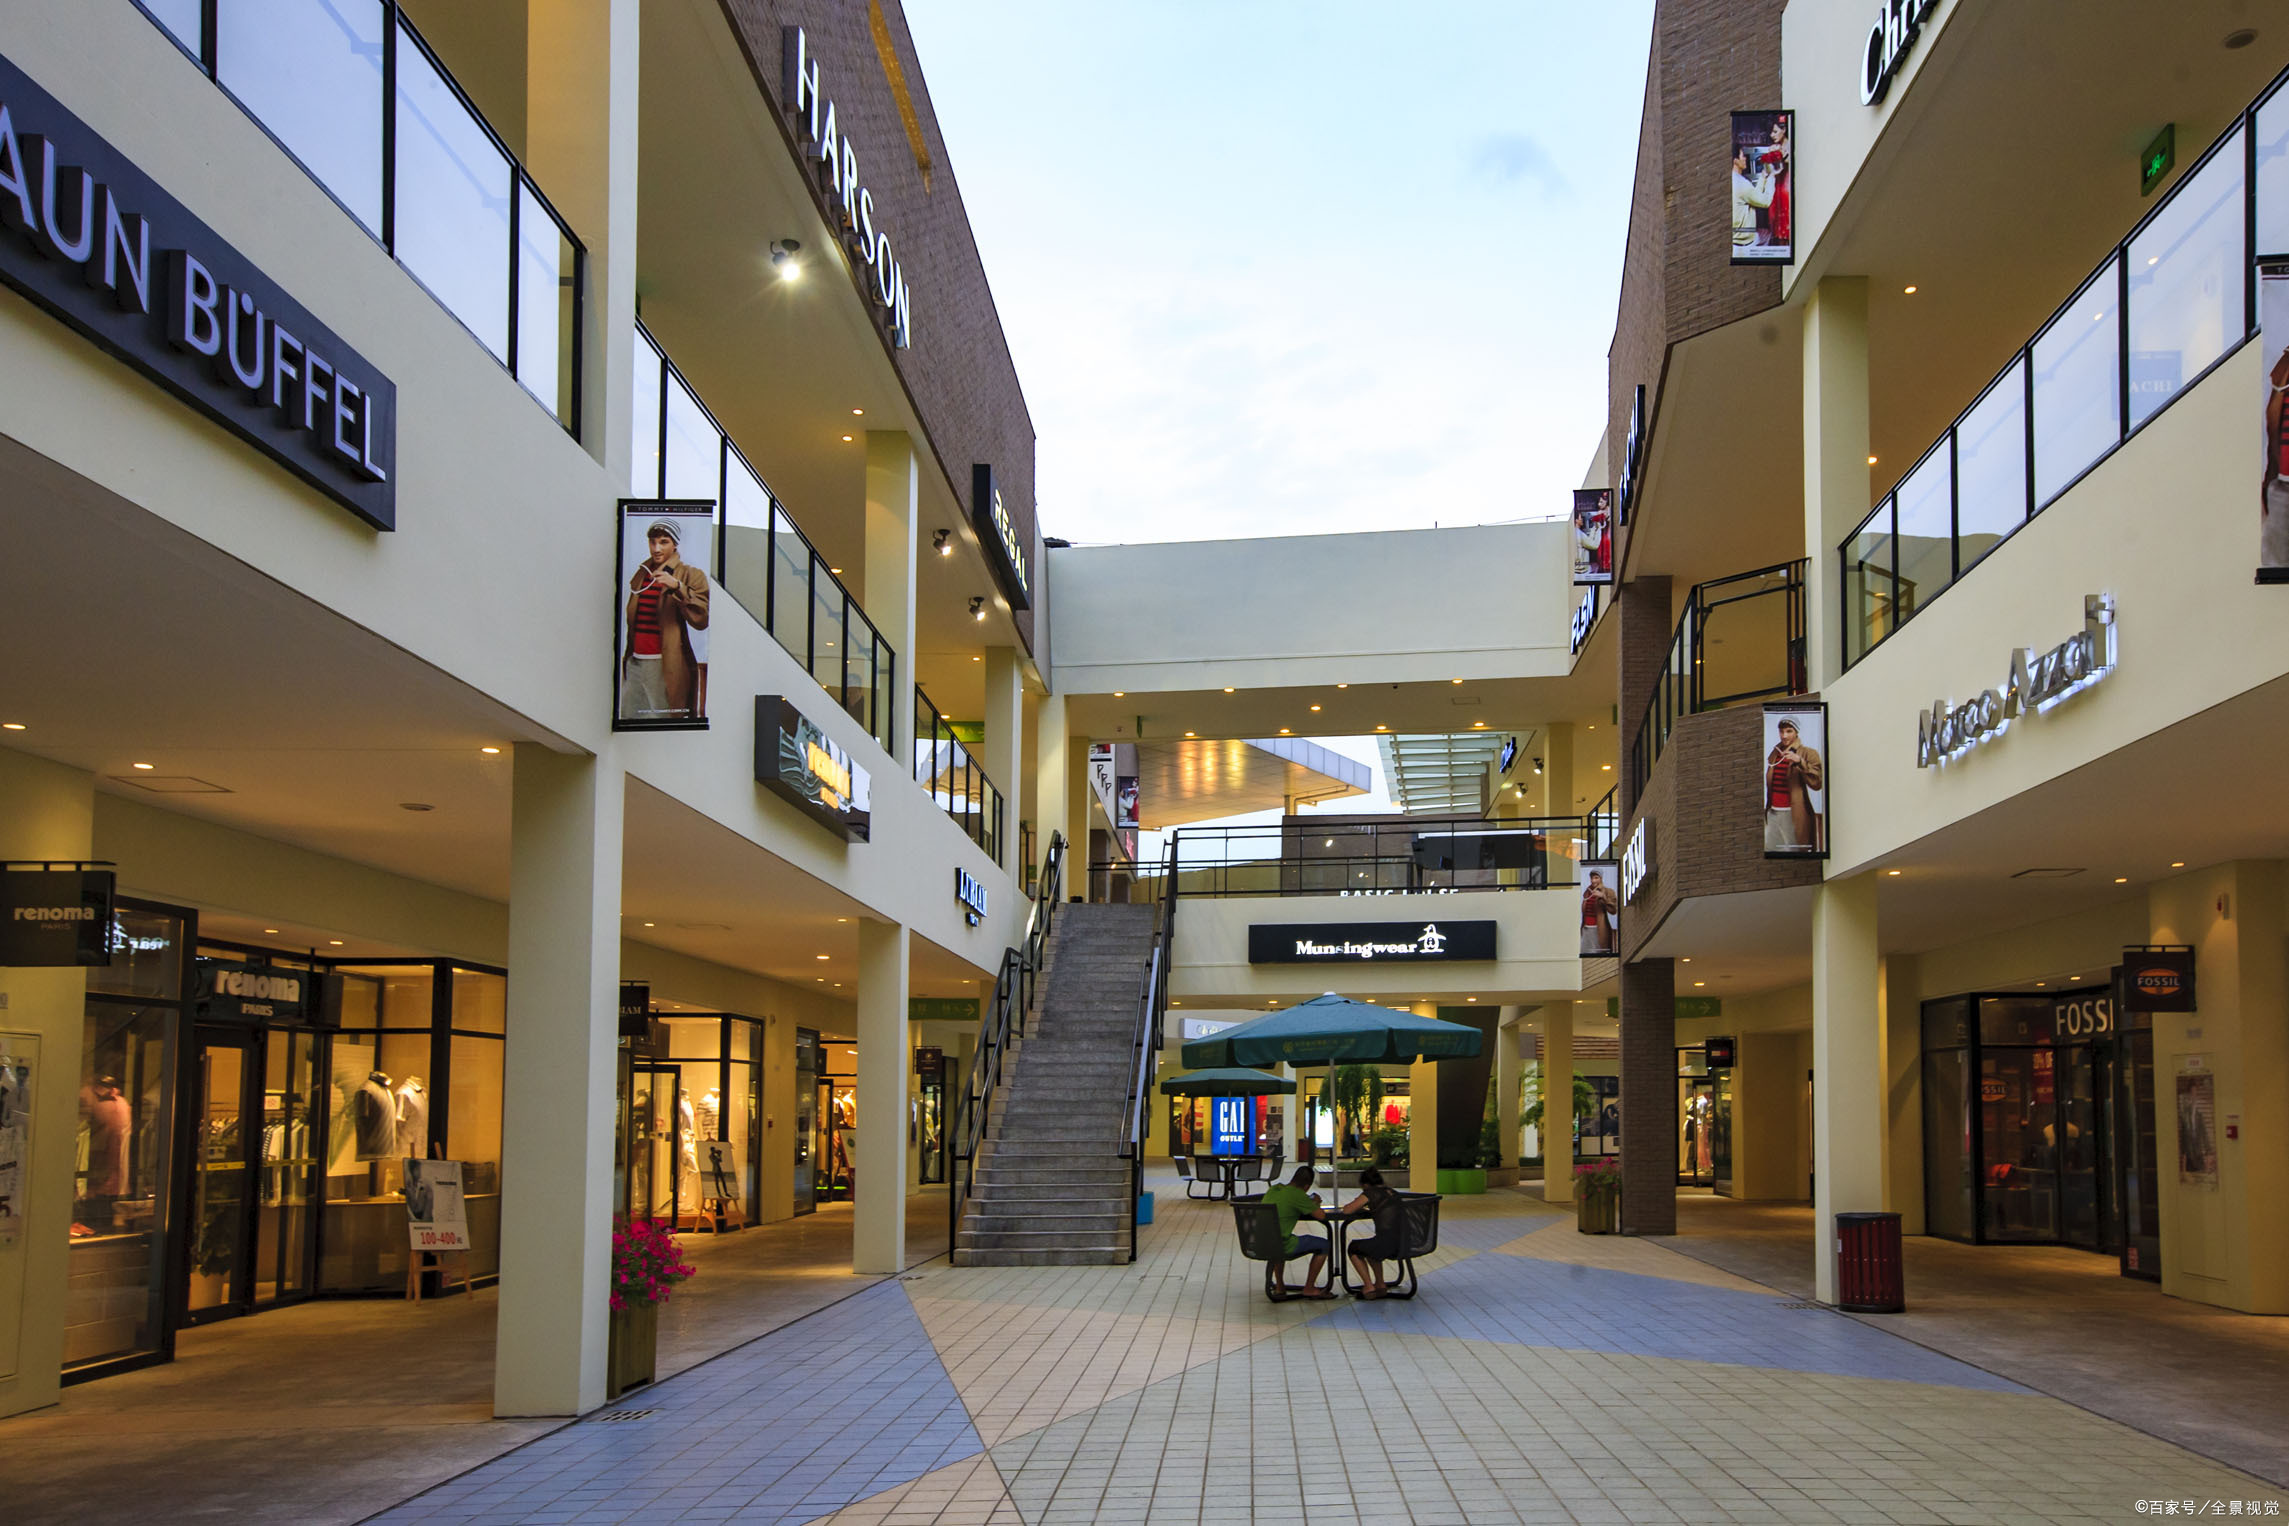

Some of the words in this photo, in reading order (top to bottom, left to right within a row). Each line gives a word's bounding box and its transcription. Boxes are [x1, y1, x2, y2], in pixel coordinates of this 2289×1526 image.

[798, 26, 910, 350] HARSON
[995, 488, 1028, 592] REGAL
[1623, 817, 1647, 908] FOSSIL
[14, 906, 95, 921] renoma
[1296, 940, 1418, 958] Munsingwear
[215, 969, 301, 1003] renoma
[2137, 976, 2180, 986] FOSSIL
[2055, 998, 2114, 1037] FOSSI
